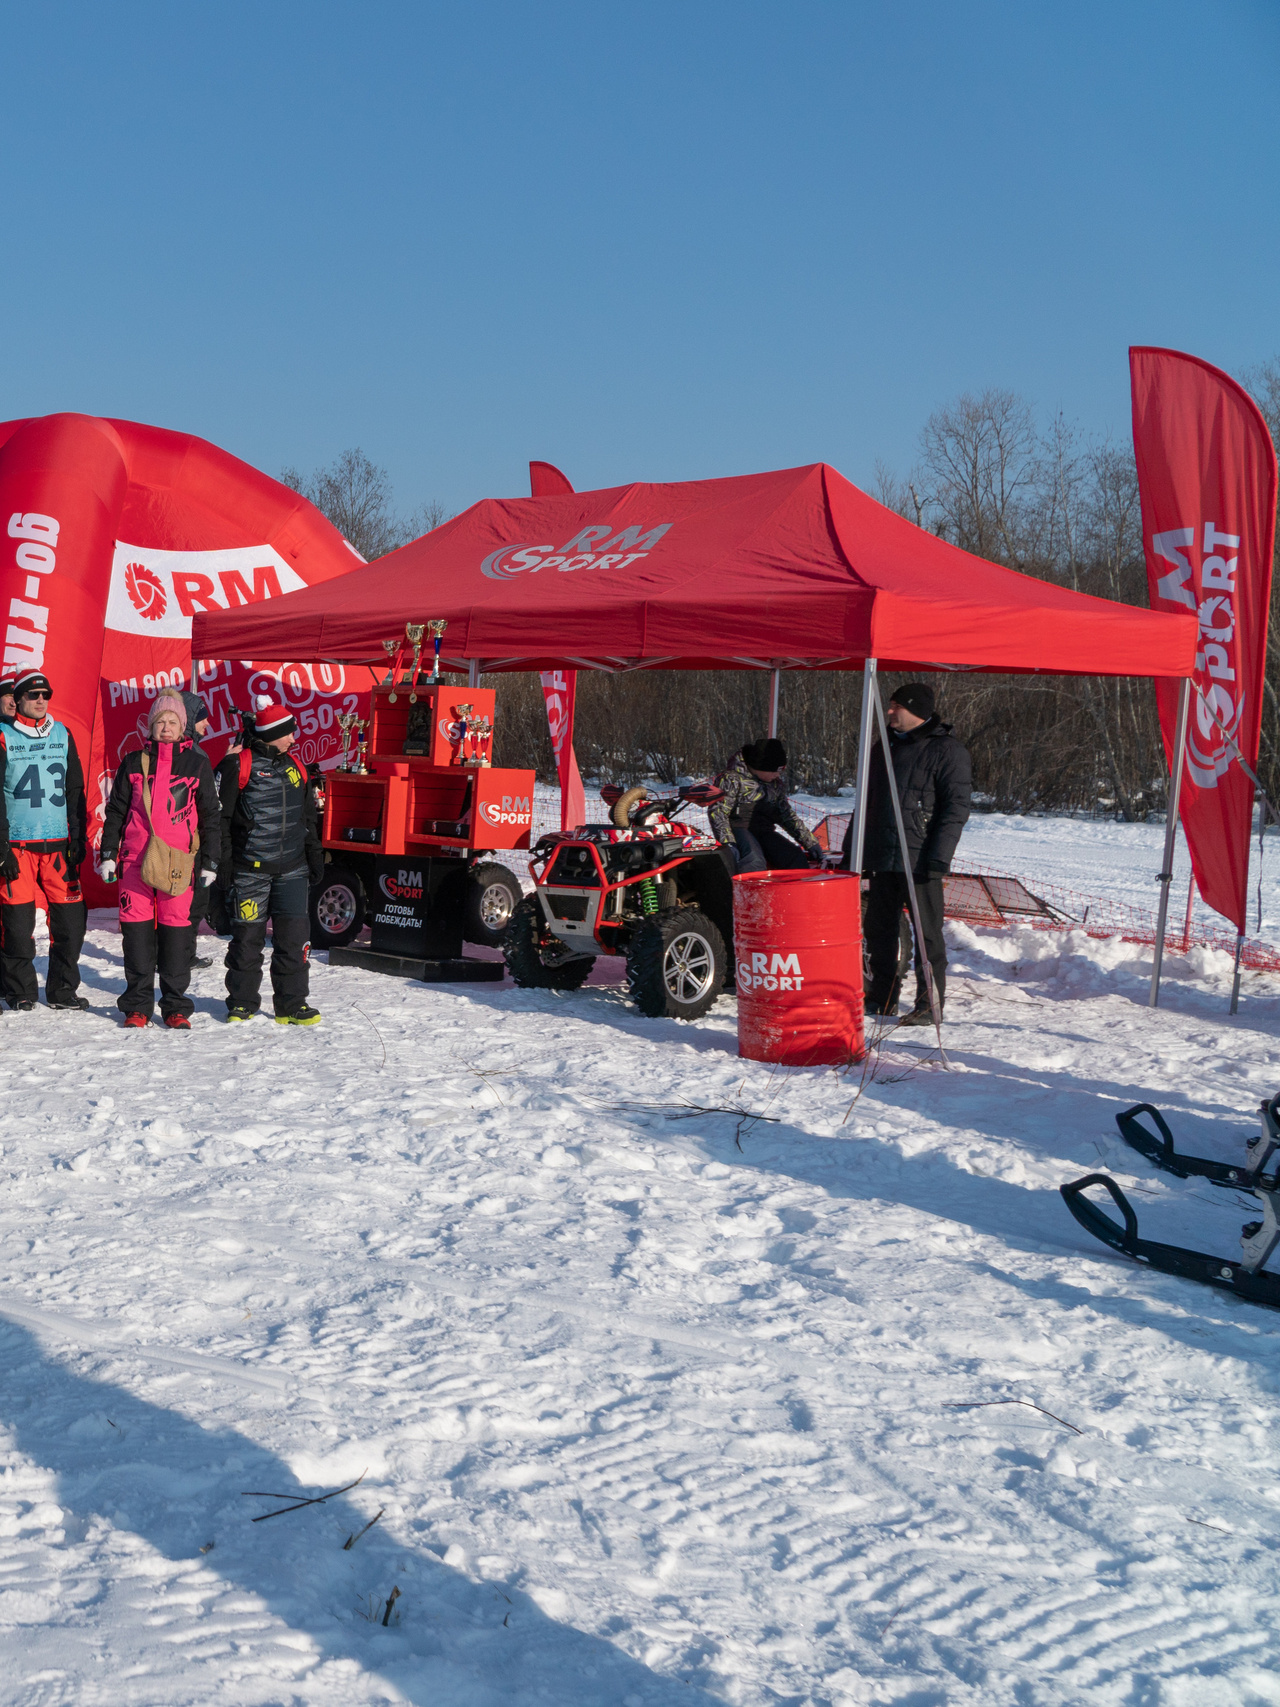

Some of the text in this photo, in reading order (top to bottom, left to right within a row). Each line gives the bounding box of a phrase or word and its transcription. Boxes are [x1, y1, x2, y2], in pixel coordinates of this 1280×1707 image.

[556, 523, 674, 553] RM
[503, 545, 649, 572] SPORT
[171, 565, 284, 617] RM
[1196, 521, 1240, 740] SPORT
[143, 667, 185, 699] 800
[14, 763, 66, 808] 43
[488, 804, 531, 825] SPORT
[502, 796, 530, 812] RM
[386, 877, 423, 899] SPORT
[398, 869, 423, 887] RM
[375, 913, 423, 928] ПОБЕЖДАТЬ!
[384, 904, 415, 916] ГОТОВЫ
[752, 952, 802, 975] RM
[739, 963, 805, 991] SPORT
